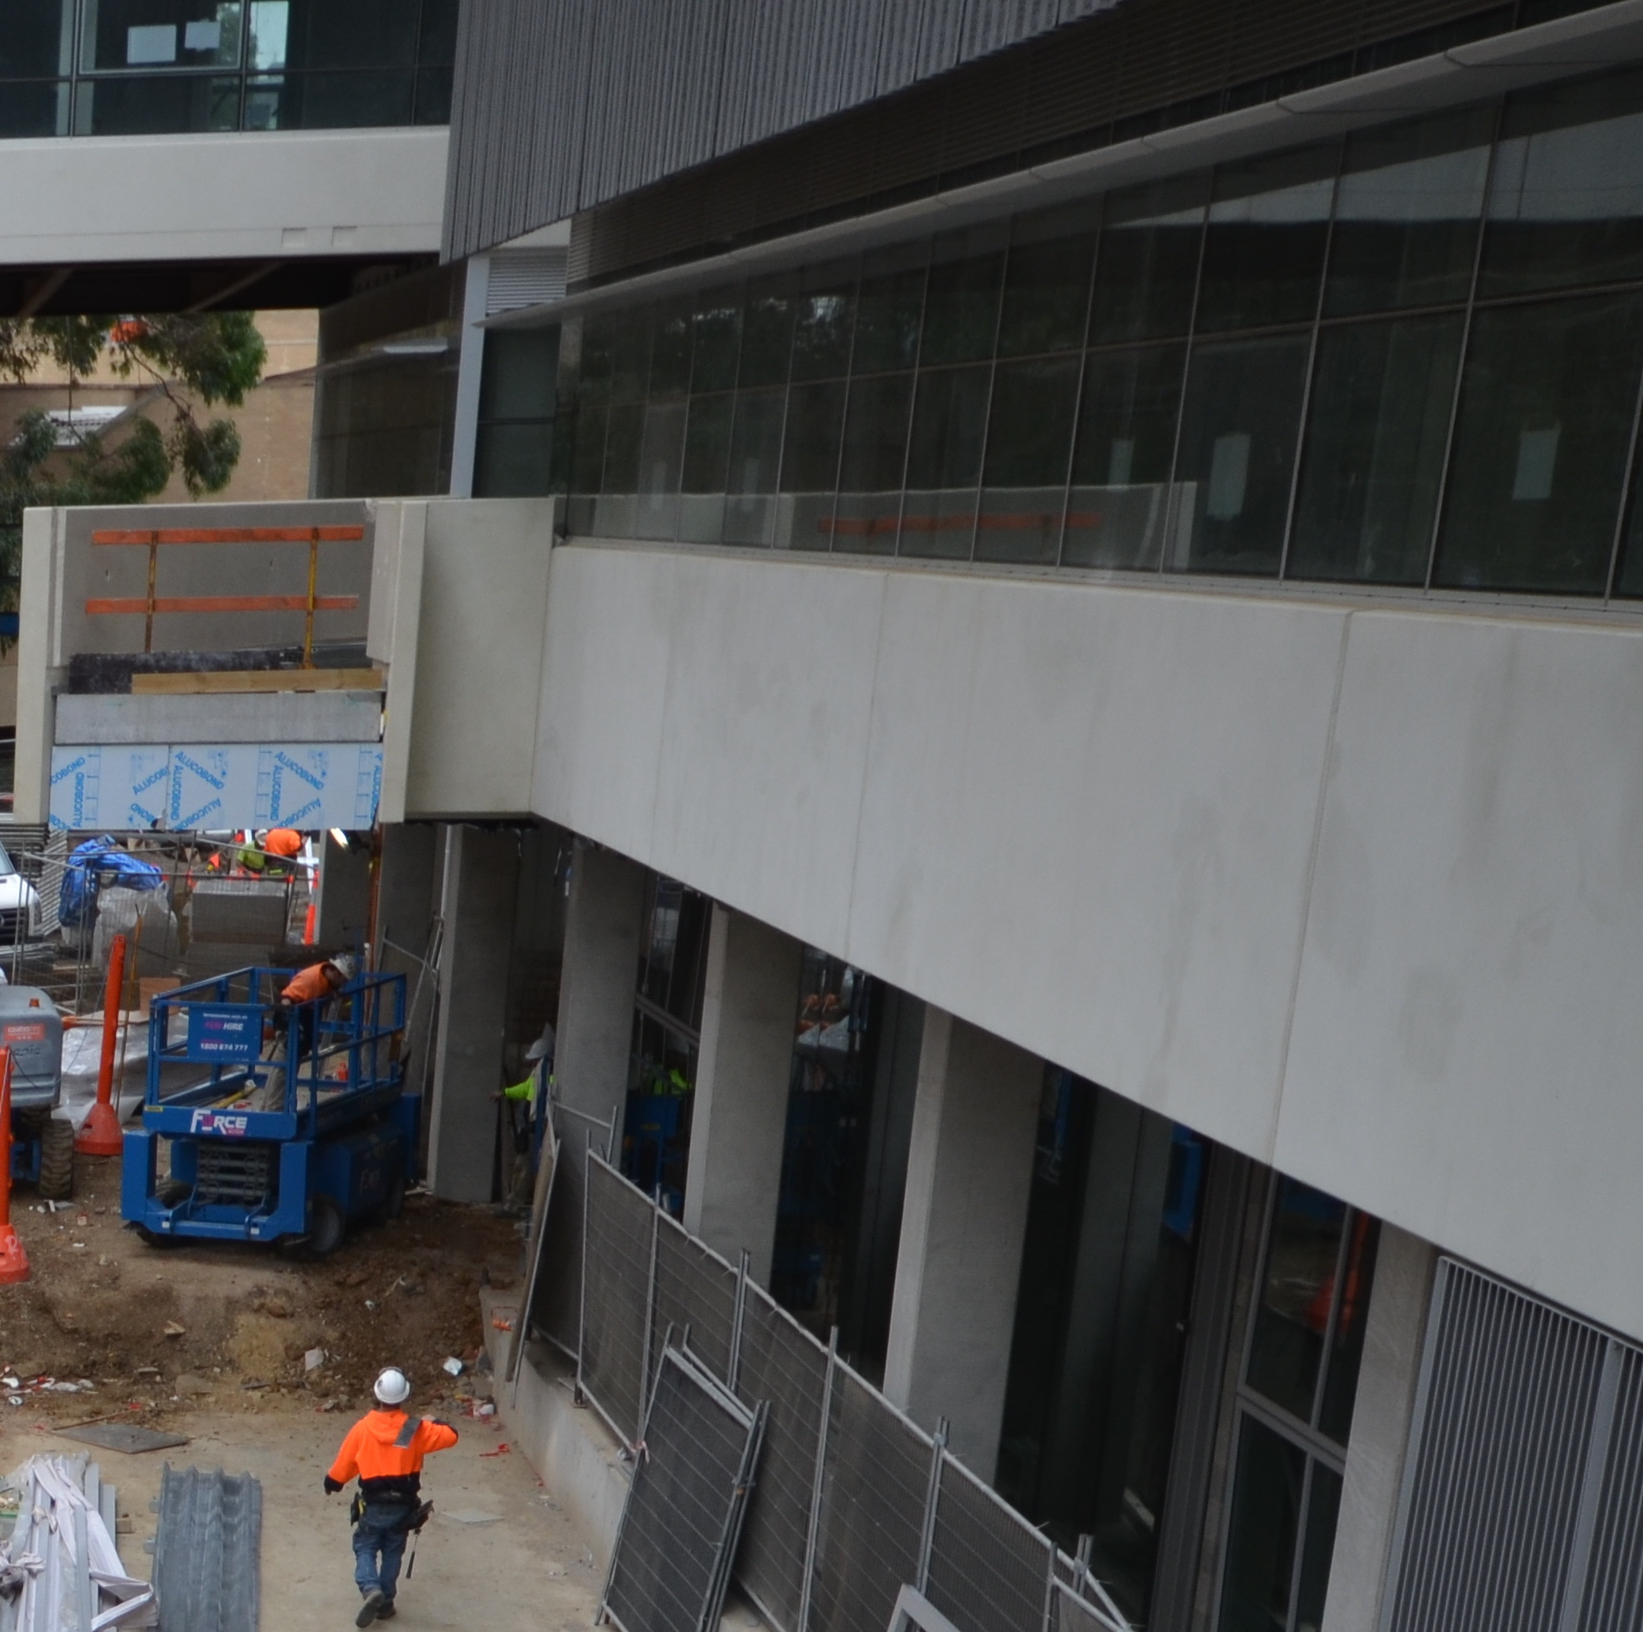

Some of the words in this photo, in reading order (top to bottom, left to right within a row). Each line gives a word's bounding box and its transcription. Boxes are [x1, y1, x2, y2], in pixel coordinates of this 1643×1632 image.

[51, 757, 86, 784] COBOND
[132, 765, 169, 795] ALUCOB
[174, 752, 224, 790] ALUCOBOND
[275, 751, 324, 790] ALUCOBOND
[72, 772, 85, 828] ALUCOBOND
[170, 764, 184, 821] ALUCOBOND
[270, 765, 283, 821] ALUCOBOND
[14, 1044, 41, 1057] enie
